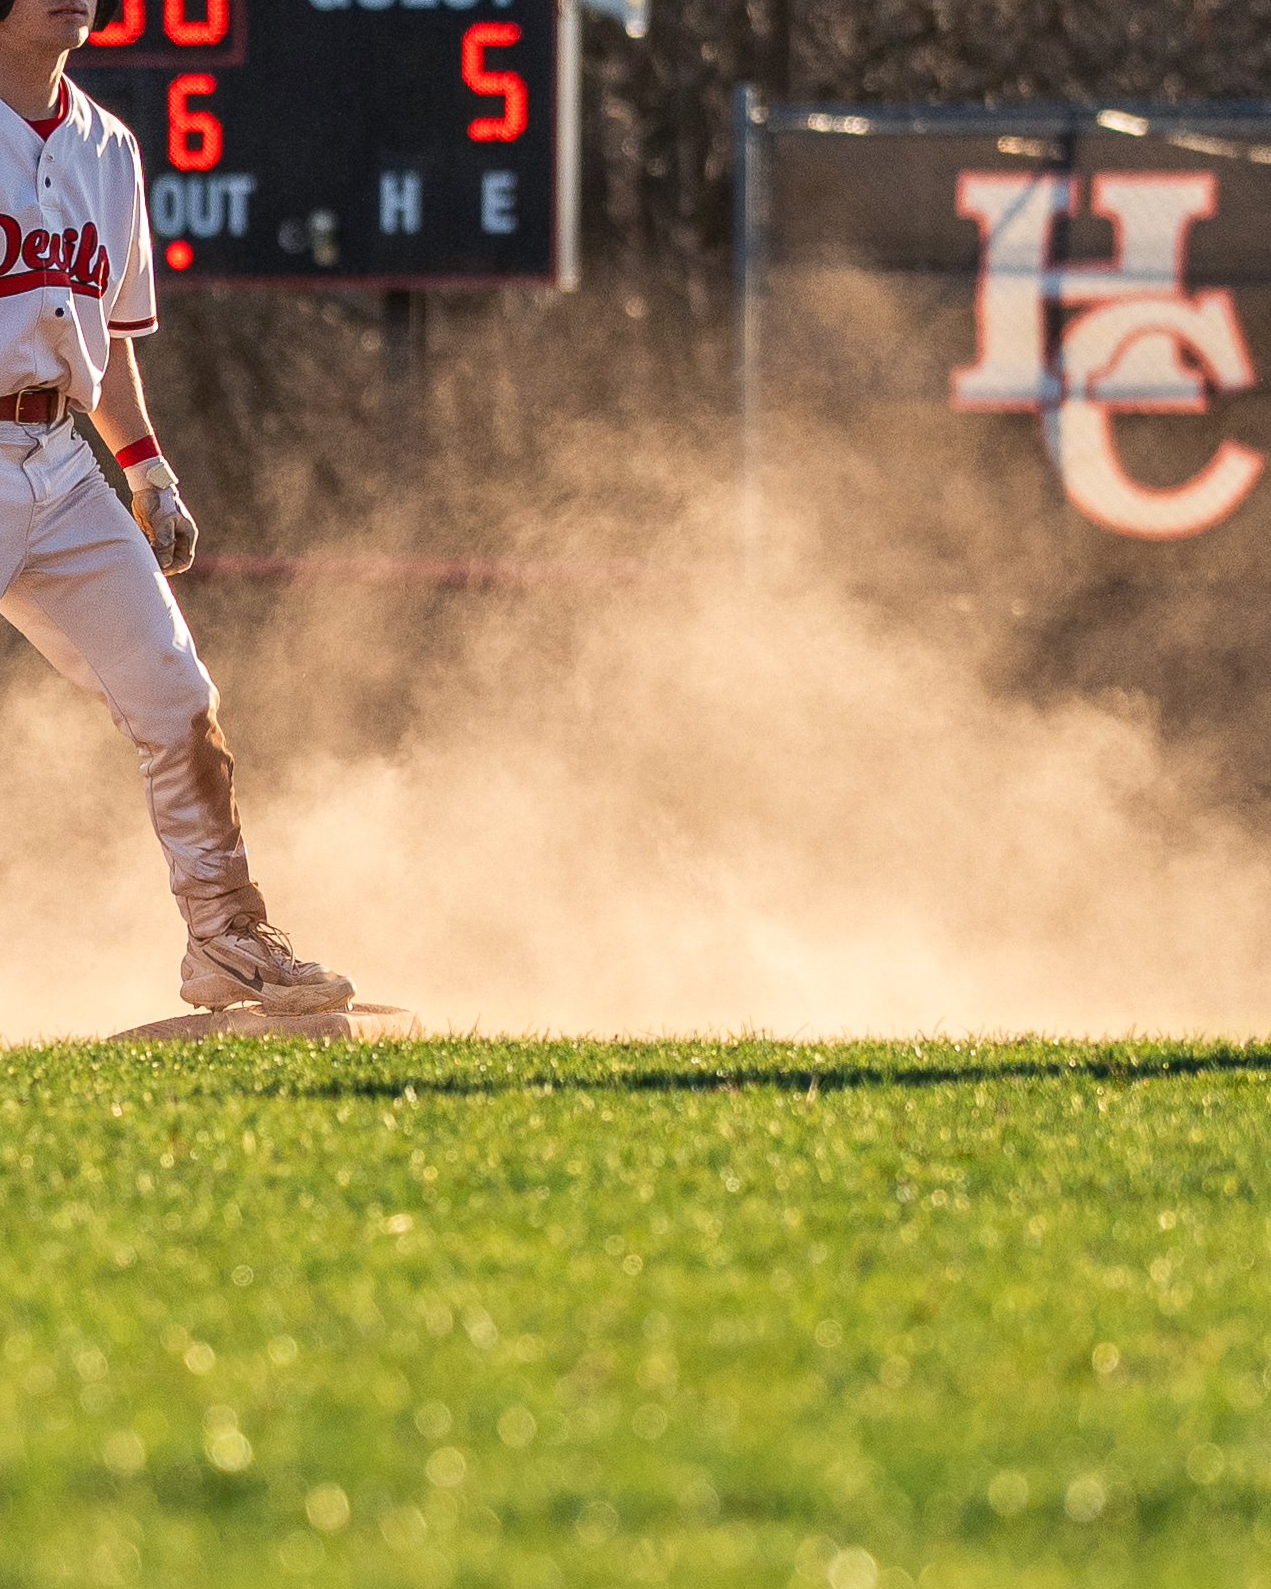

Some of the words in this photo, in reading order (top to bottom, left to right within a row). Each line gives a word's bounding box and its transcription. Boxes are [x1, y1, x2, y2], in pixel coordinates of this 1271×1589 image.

[167, 73, 222, 171] 6
[461, 21, 527, 142] 5
[151, 173, 257, 238] OUT
[379, 170, 421, 235] H
[480, 170, 519, 235] E
[951, 171, 1265, 539] HC
